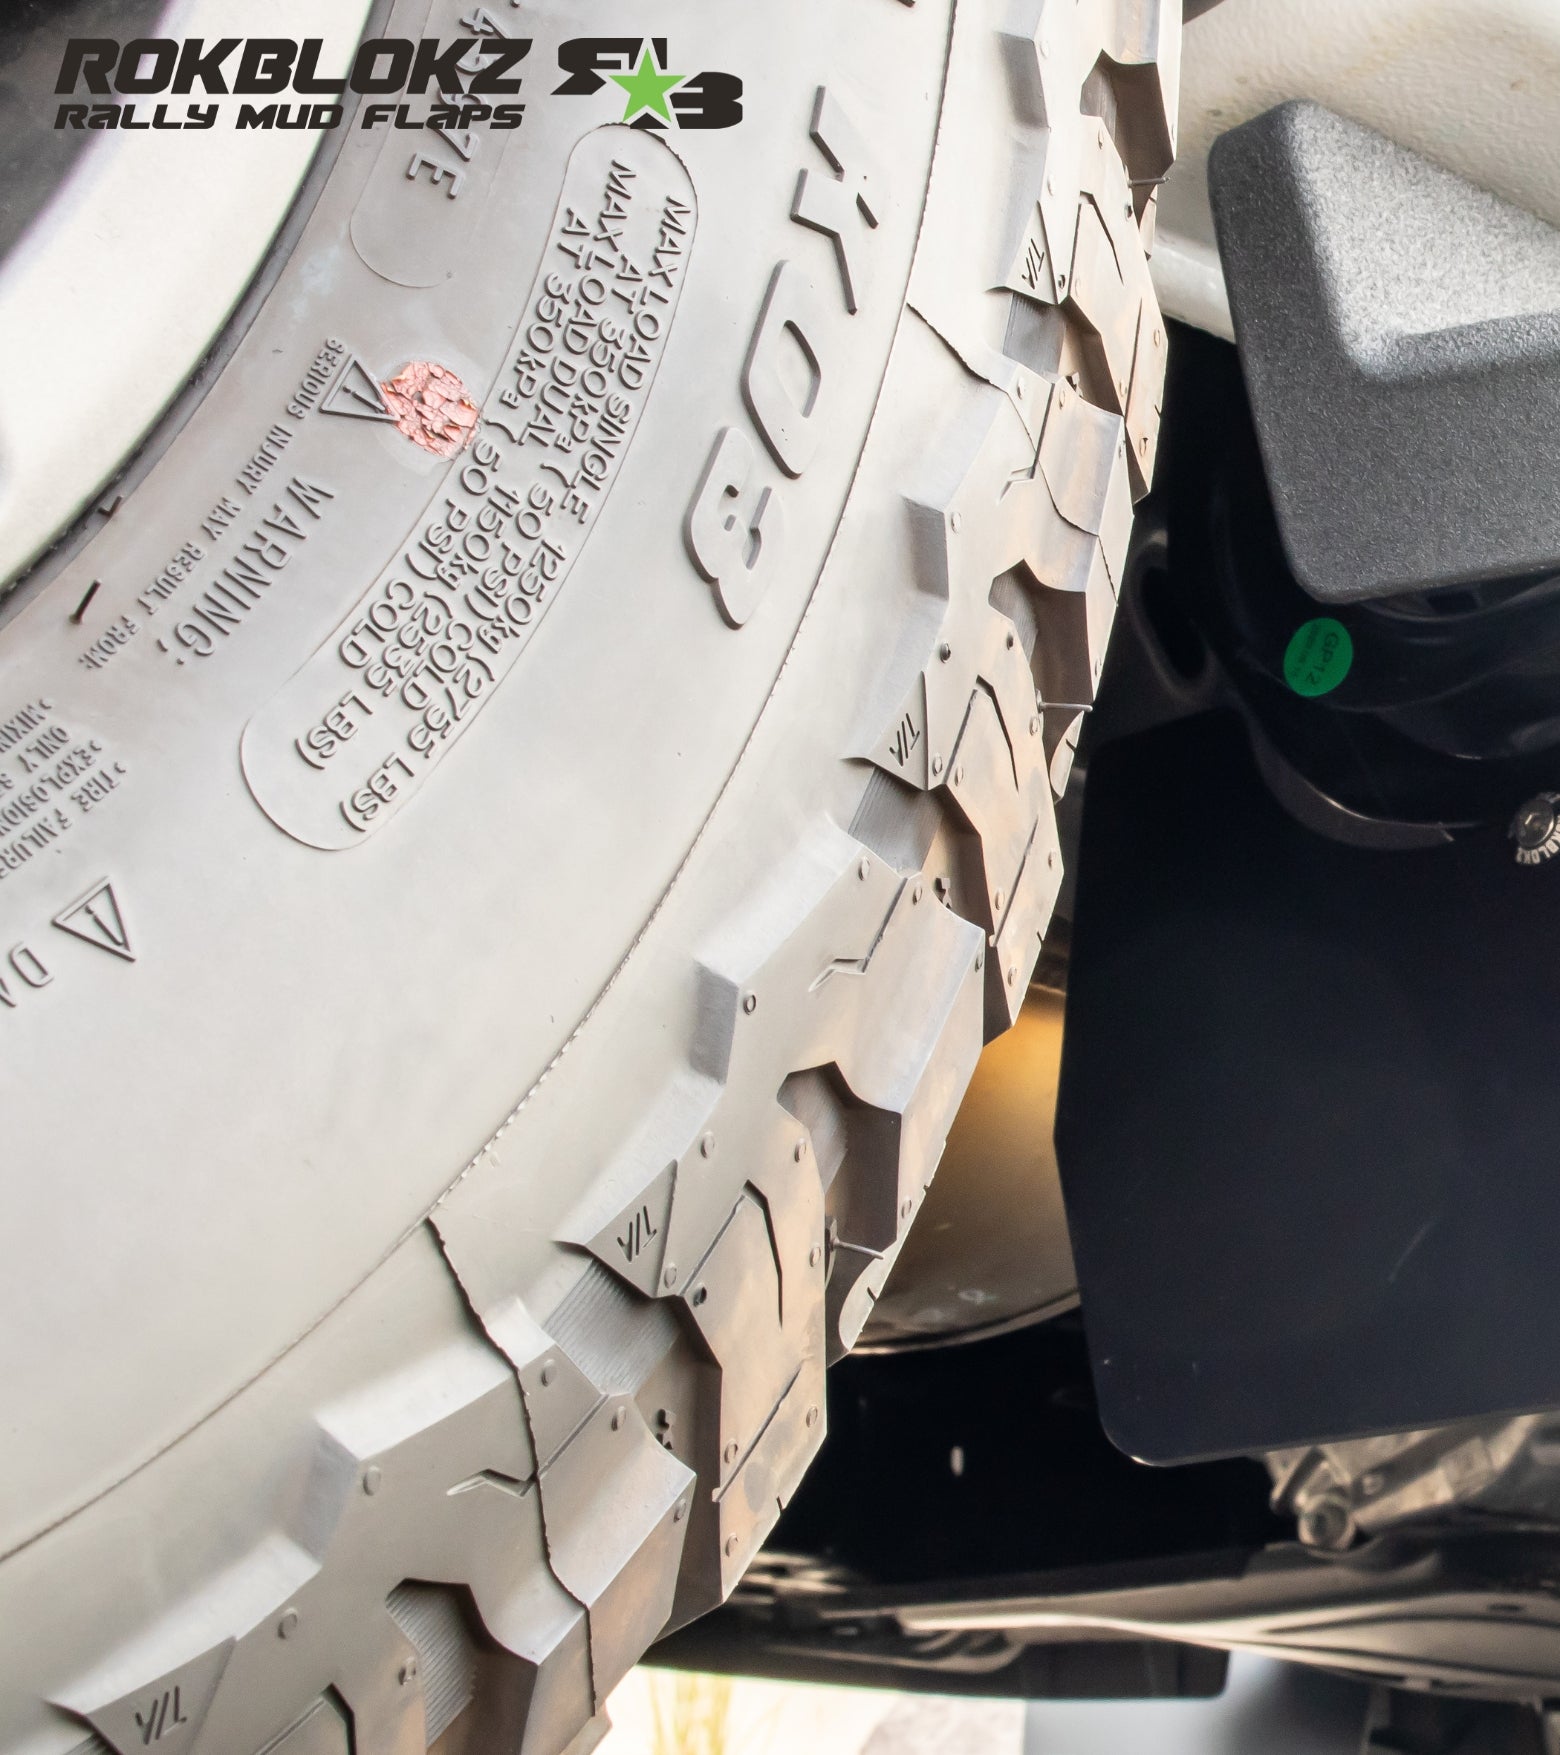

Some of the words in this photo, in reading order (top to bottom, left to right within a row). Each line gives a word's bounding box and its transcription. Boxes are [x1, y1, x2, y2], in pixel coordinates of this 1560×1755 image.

[557, 207, 592, 269] AT
[594, 158, 637, 253] MAX
[650, 195, 692, 289] MAX
[561, 245, 615, 356] LOAD
[610, 253, 643, 314] AT
[287, 336, 345, 420] SERIOUS
[618, 286, 668, 391] LOAD
[517, 356, 578, 447] DUAL
[236, 424, 293, 495] INJURY
[559, 392, 632, 525] SINGLE
[202, 497, 241, 541] MAY
[405, 499, 471, 580] PSI)
[138, 543, 207, 616] RESULT
[464, 541, 522, 621] PSI)
[338, 577, 416, 669] COLD
[401, 619, 474, 711] COLD
[18, 725, 69, 774] ONLY
[295, 690, 374, 770] LBS)
[339, 751, 415, 832] LBS)
